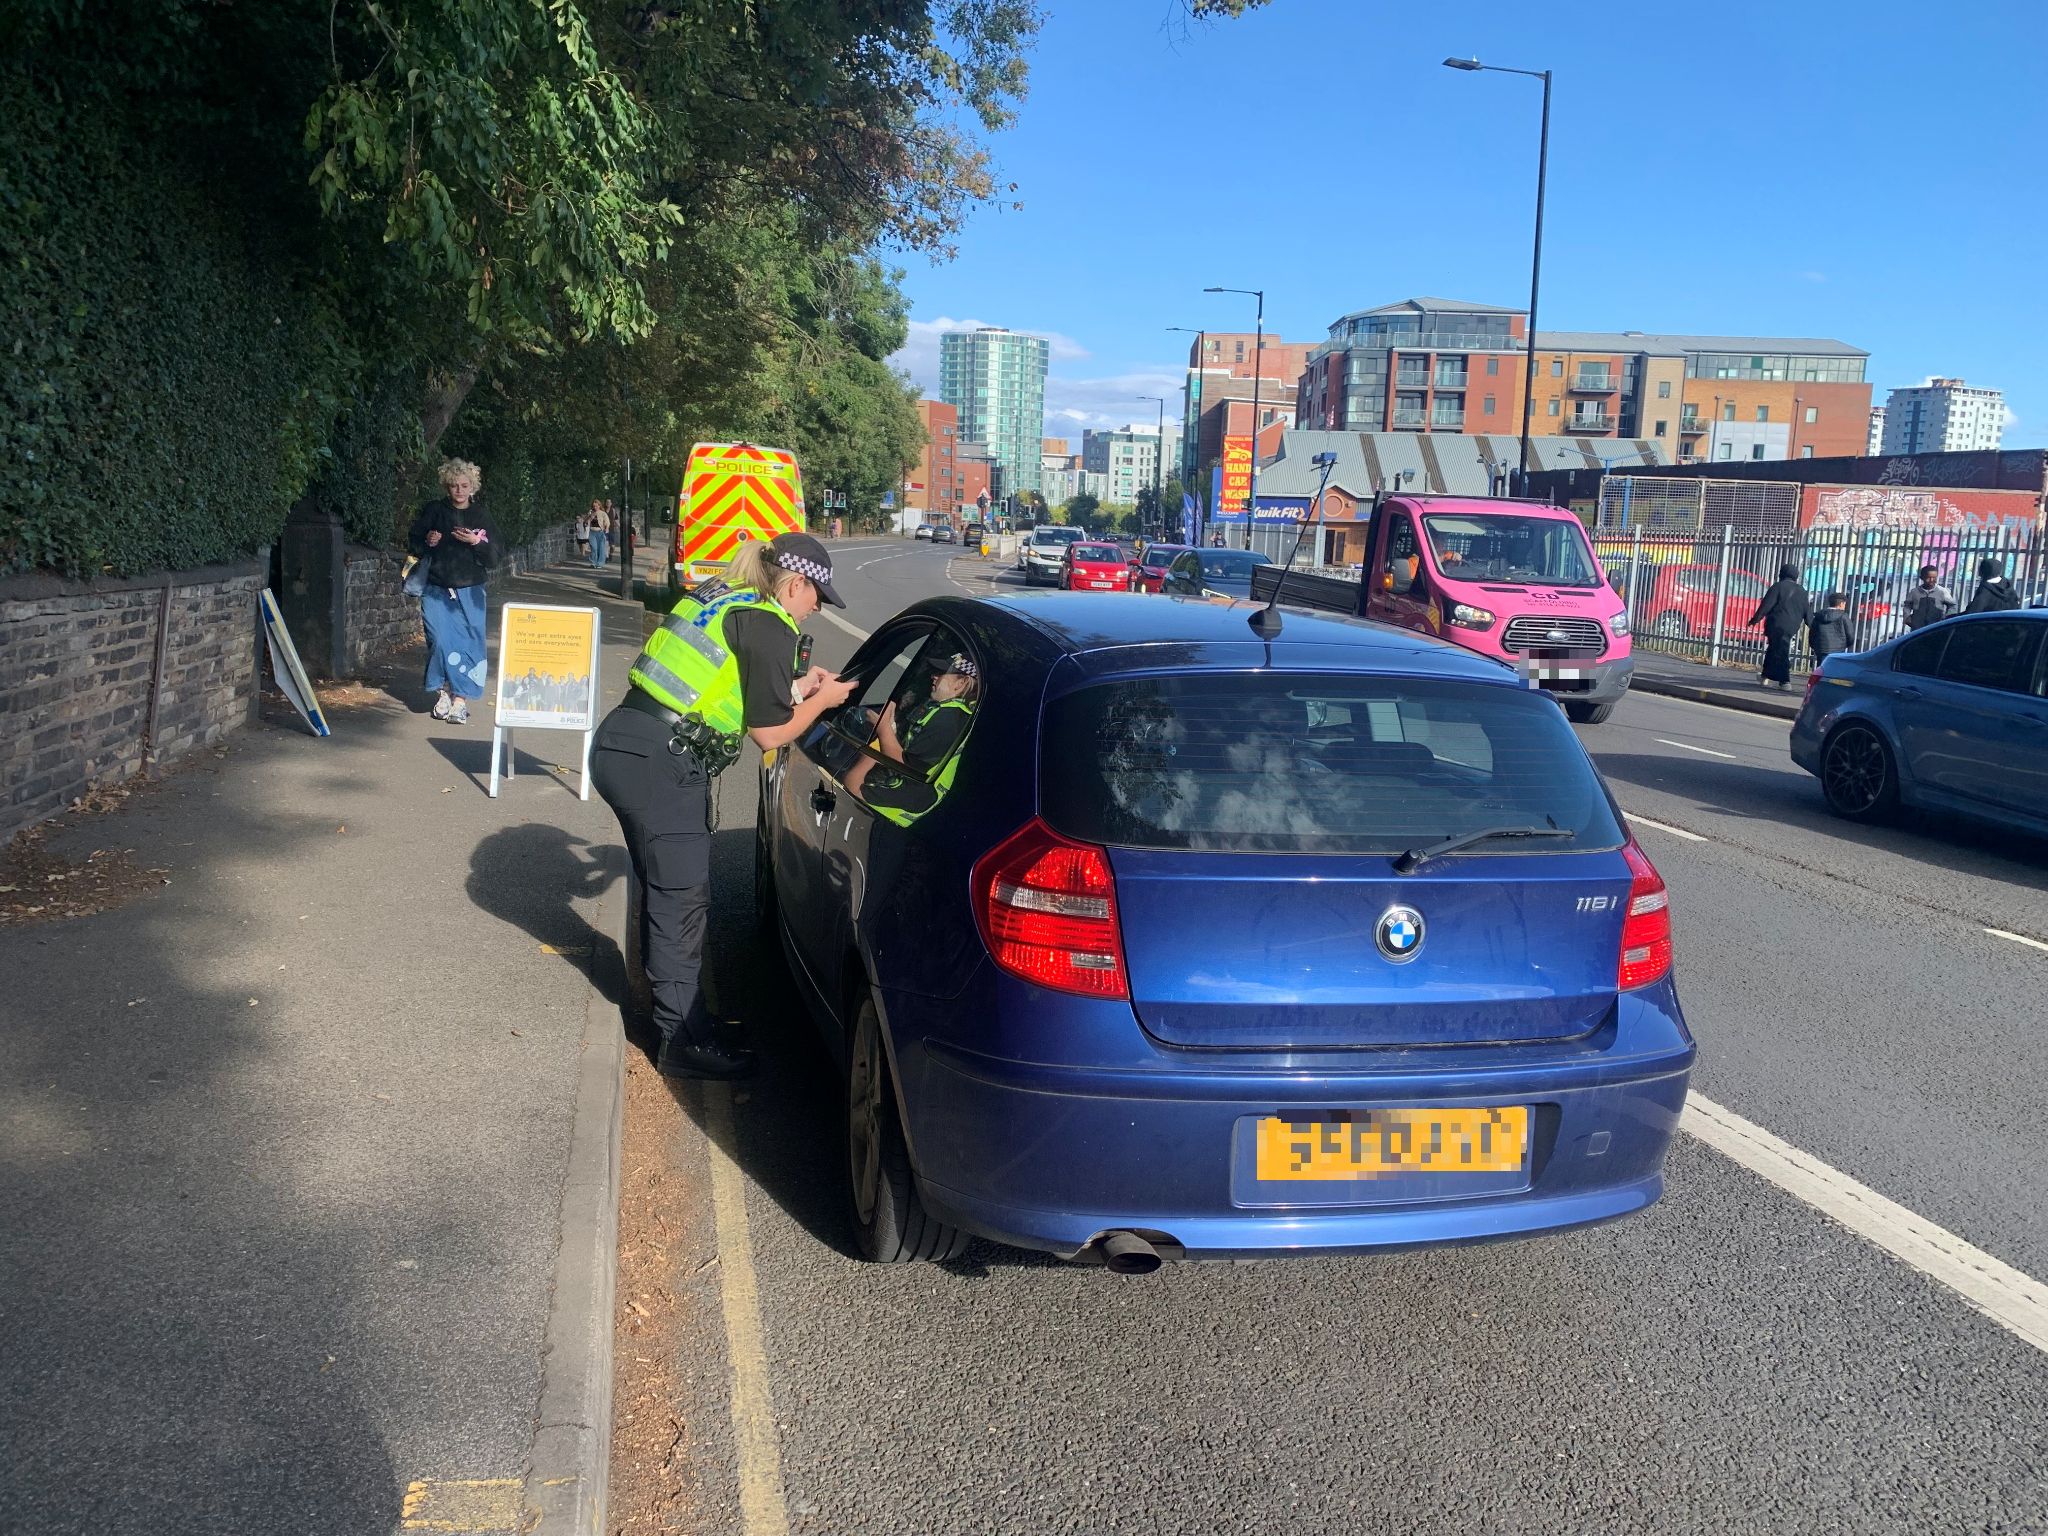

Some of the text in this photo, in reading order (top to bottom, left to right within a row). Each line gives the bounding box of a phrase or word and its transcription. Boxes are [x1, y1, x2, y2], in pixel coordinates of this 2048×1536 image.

[716, 462, 772, 475] POLICE
[1226, 463, 1251, 473] HAND
[1229, 476, 1248, 487] CAR
[1224, 489, 1250, 499] WASH
[1575, 896, 1617, 912] 118i
[1386, 913, 1421, 927] BMW
